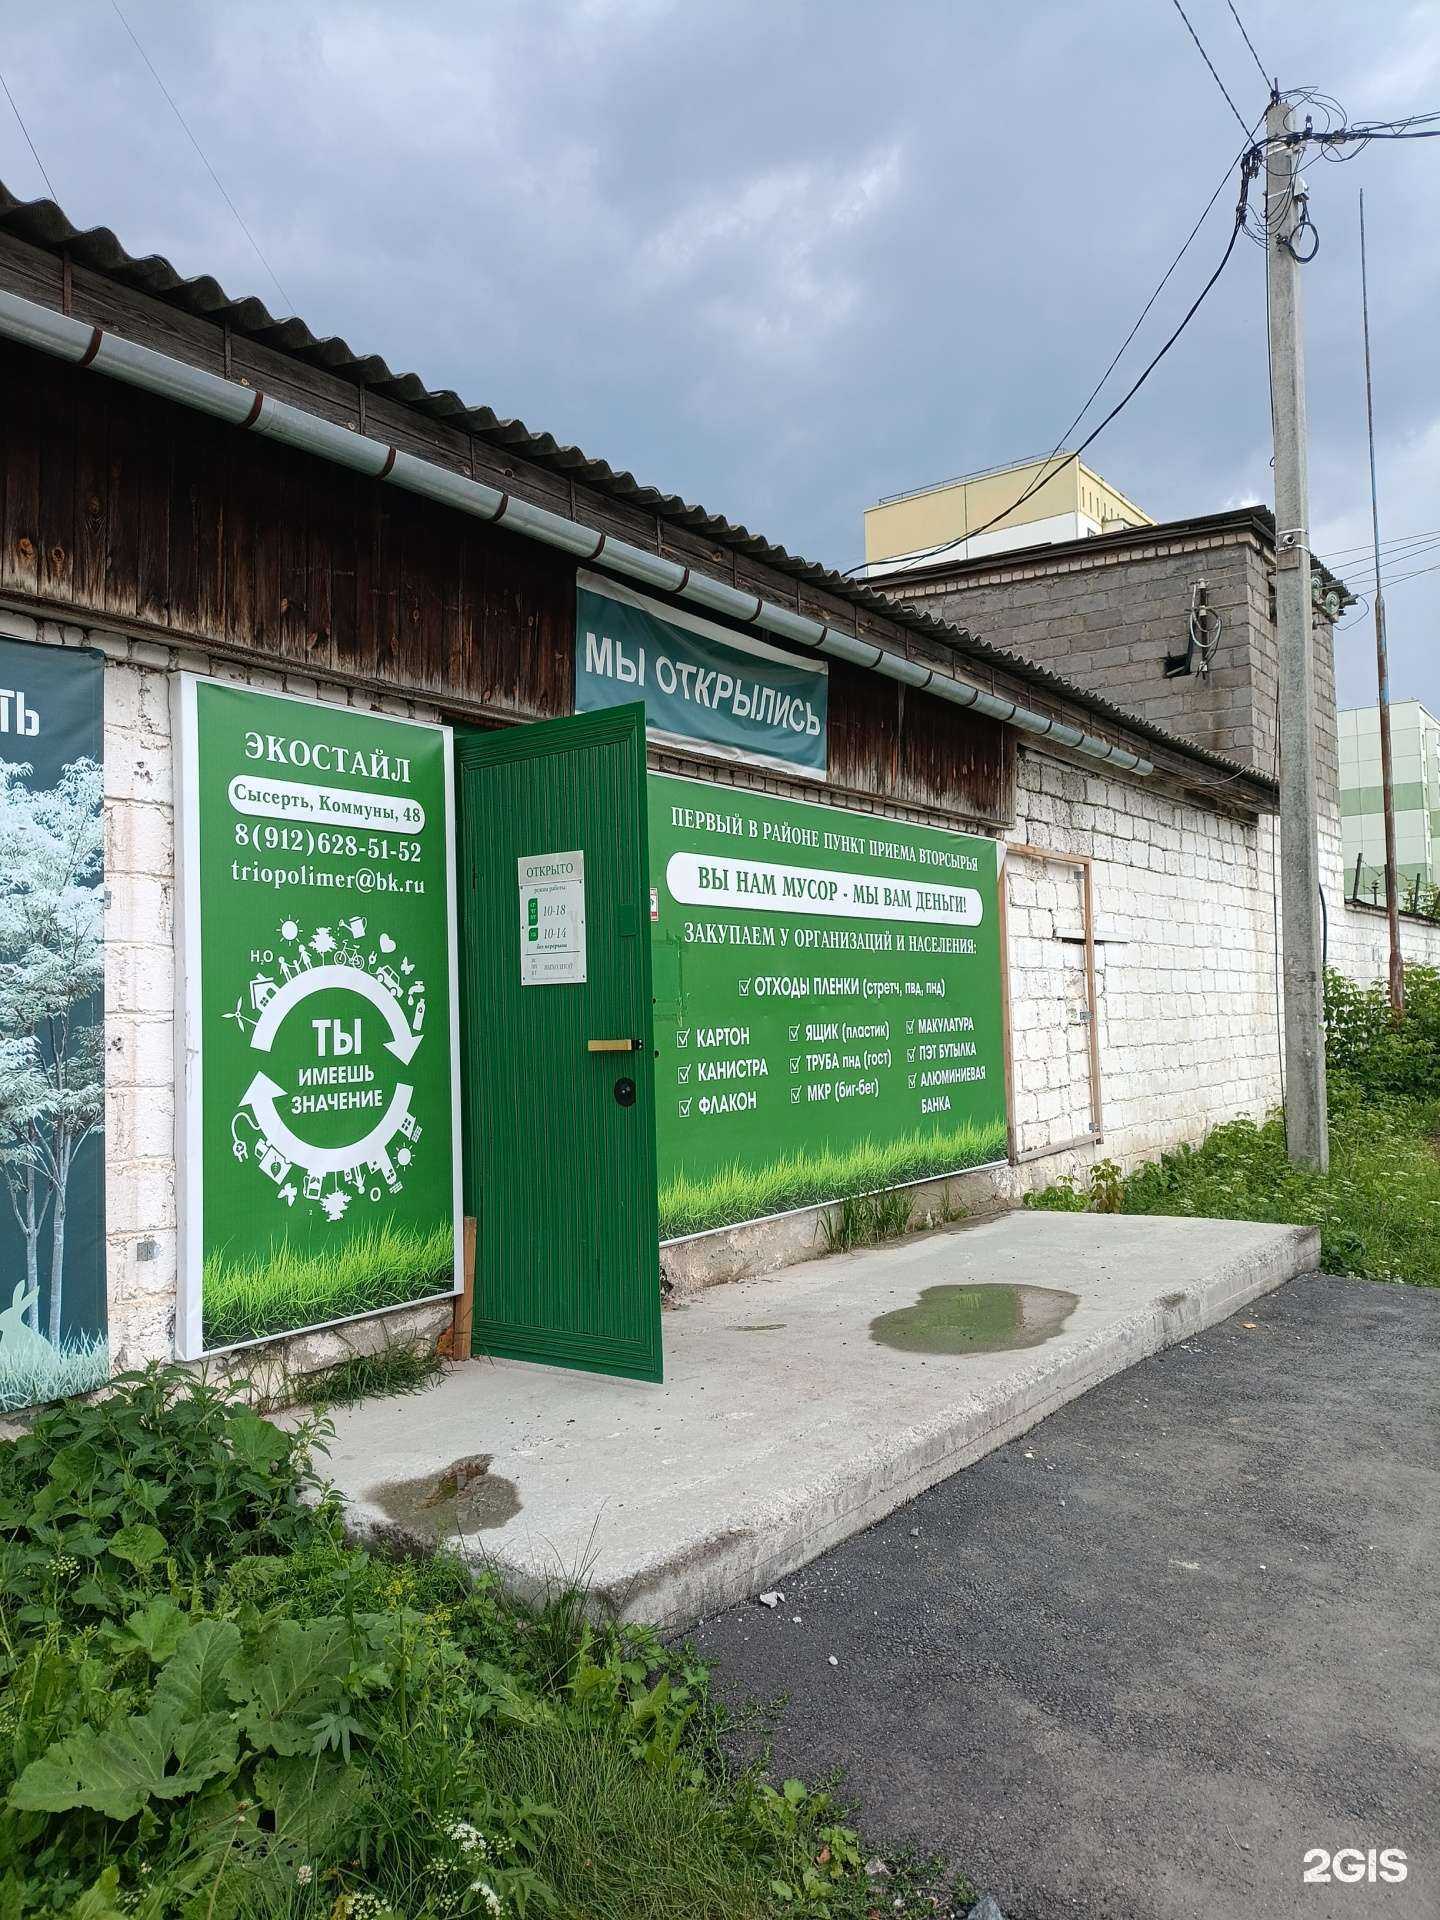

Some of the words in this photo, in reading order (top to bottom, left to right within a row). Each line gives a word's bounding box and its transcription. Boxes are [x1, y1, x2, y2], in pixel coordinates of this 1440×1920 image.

[586, 632, 645, 687] МЫ
[655, 655, 821, 736] ОТКРЫЛИСЬ
[244, 731, 411, 783] ЭКОСТАЙЛ
[233, 783, 314, 812] Сысерть,
[319, 795, 399, 823] Коммуны,
[402, 806, 421, 823] 48
[235, 823, 422, 863] 8(912)628-51-52
[670, 806, 744, 836] ПЕРВЫЙ
[748, 820, 759, 839] В
[762, 821, 820, 849] РАЙОНЕ
[824, 833, 866, 855] ПУНКТ
[869, 838, 917, 862] ПРИЕМА
[919, 850, 979, 872] ВТОРСЫРЬЯ
[231, 860, 425, 894] triopolimer@bk.ru
[526, 863, 574, 878] ОТКРЫТО
[698, 866, 730, 892] ВЫ
[736, 871, 776, 896] НАМ
[783, 876, 838, 902] МУСОР
[853, 884, 879, 905] МЫ
[884, 888, 913, 909] ВАМ
[915, 891, 967, 914] ДЕНЬГИ!
[543, 904, 566, 917] 10-18
[684, 922, 776, 947] ЗАКУПАЕМ
[780, 928, 790, 948] У
[794, 929, 893, 954] ОРГАНИЗАЦИЙ
[896, 932, 905, 952] И
[909, 935, 978, 955] НАСЕЛЕНИЯ:
[754, 976, 809, 999] ОТХОДЫ
[813, 977, 860, 996] ПЛЕНКИ
[863, 976, 902, 999] (стретч,
[905, 982, 924, 998] пвд,
[926, 977, 946, 998] пнд)
[312, 1018, 362, 1057] ТЫ
[696, 1027, 751, 1048] КАРТОН
[805, 1023, 839, 1042] ЯЩИК
[841, 1021, 890, 1043] (пластик)
[918, 1017, 975, 1035] МАКУЛАТУРА
[806, 1053, 840, 1072] ТРУБА
[842, 1055, 861, 1070] пнд
[863, 1049, 892, 1071] (гост)
[919, 1045, 938, 1061] ПЭТ
[938, 1042, 977, 1060] БУТЫЛКА
[299, 1064, 375, 1087] ИМЕЕШЬ
[698, 1057, 769, 1082] КАНИСТРА
[920, 1066, 986, 1087] АЛЮМИНИЕВАЯ
[291, 1089, 383, 1115] ЗНАЧЕНИЕ
[698, 1091, 757, 1115] ФЛАКОН
[807, 1084, 832, 1102] МКР
[834, 1079, 880, 1103] (биг-бег)
[921, 1095, 951, 1114] БАНКА
